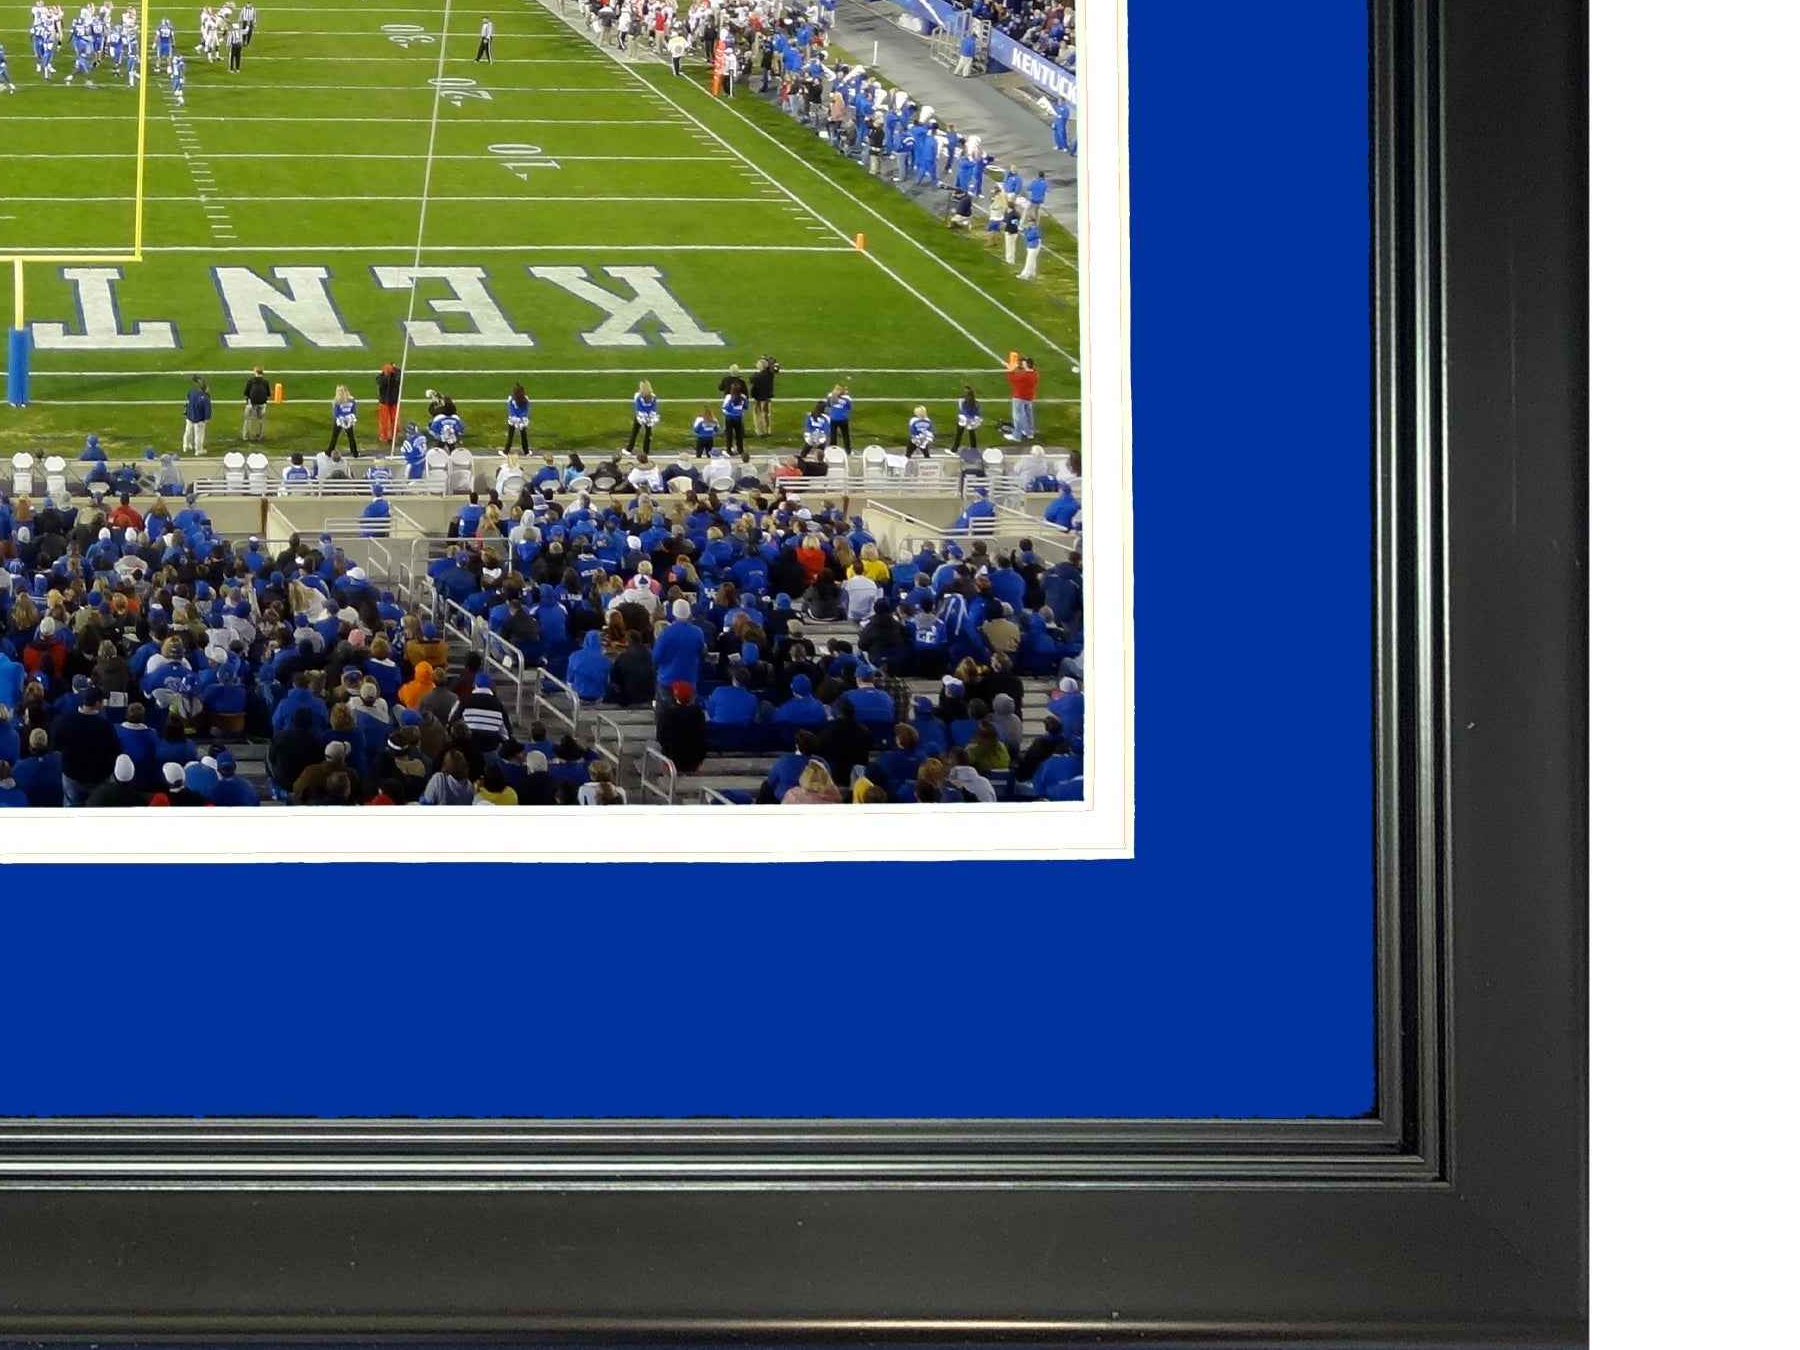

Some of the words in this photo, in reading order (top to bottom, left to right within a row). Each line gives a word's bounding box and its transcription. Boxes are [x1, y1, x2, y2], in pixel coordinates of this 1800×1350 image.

[380, 24, 436, 43] 30
[427, 77, 493, 100] 20
[488, 143, 561, 169] 10
